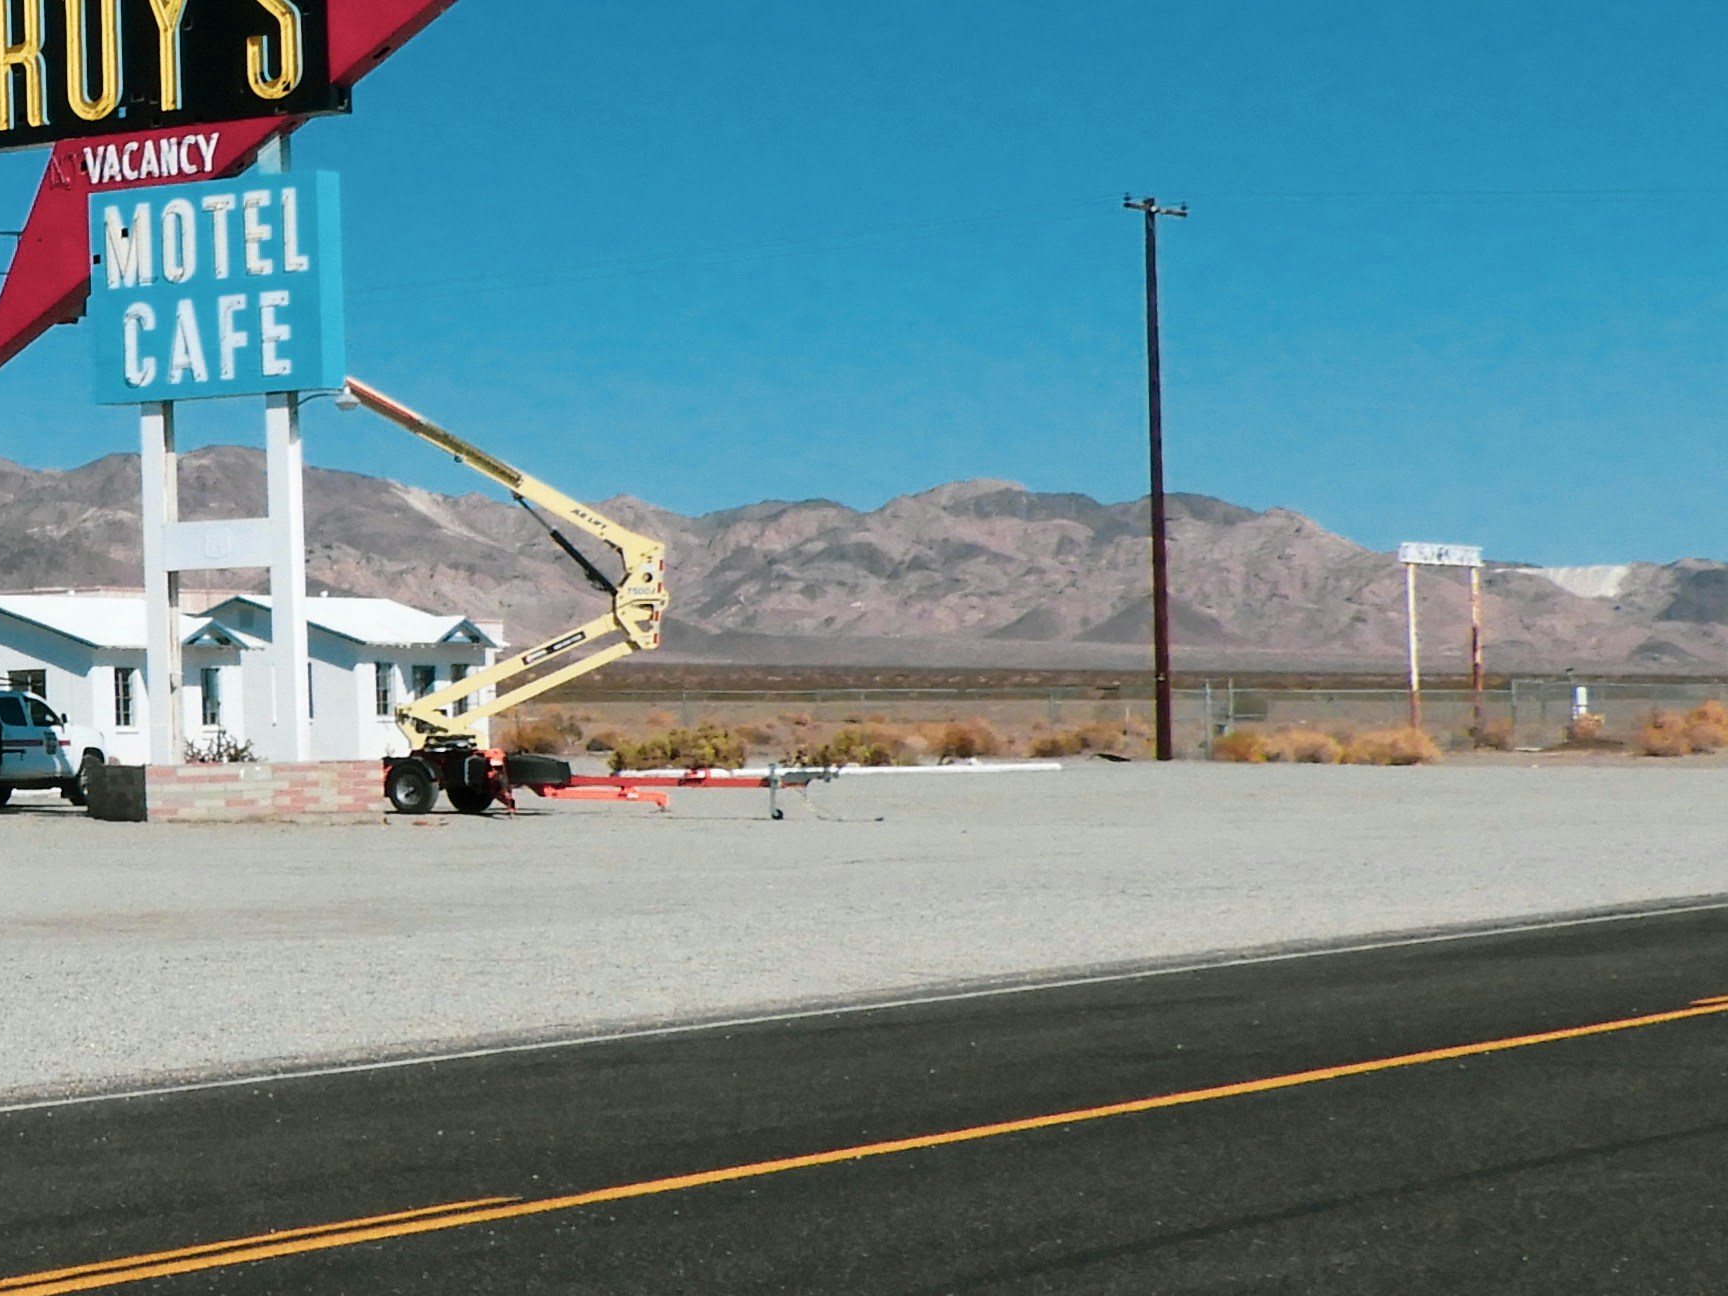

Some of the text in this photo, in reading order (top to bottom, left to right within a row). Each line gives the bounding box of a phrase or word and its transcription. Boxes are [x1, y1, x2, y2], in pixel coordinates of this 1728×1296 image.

[82, 132, 219, 184] VACANCY
[103, 187, 310, 290] MOTEL
[122, 290, 292, 388] CAFE
